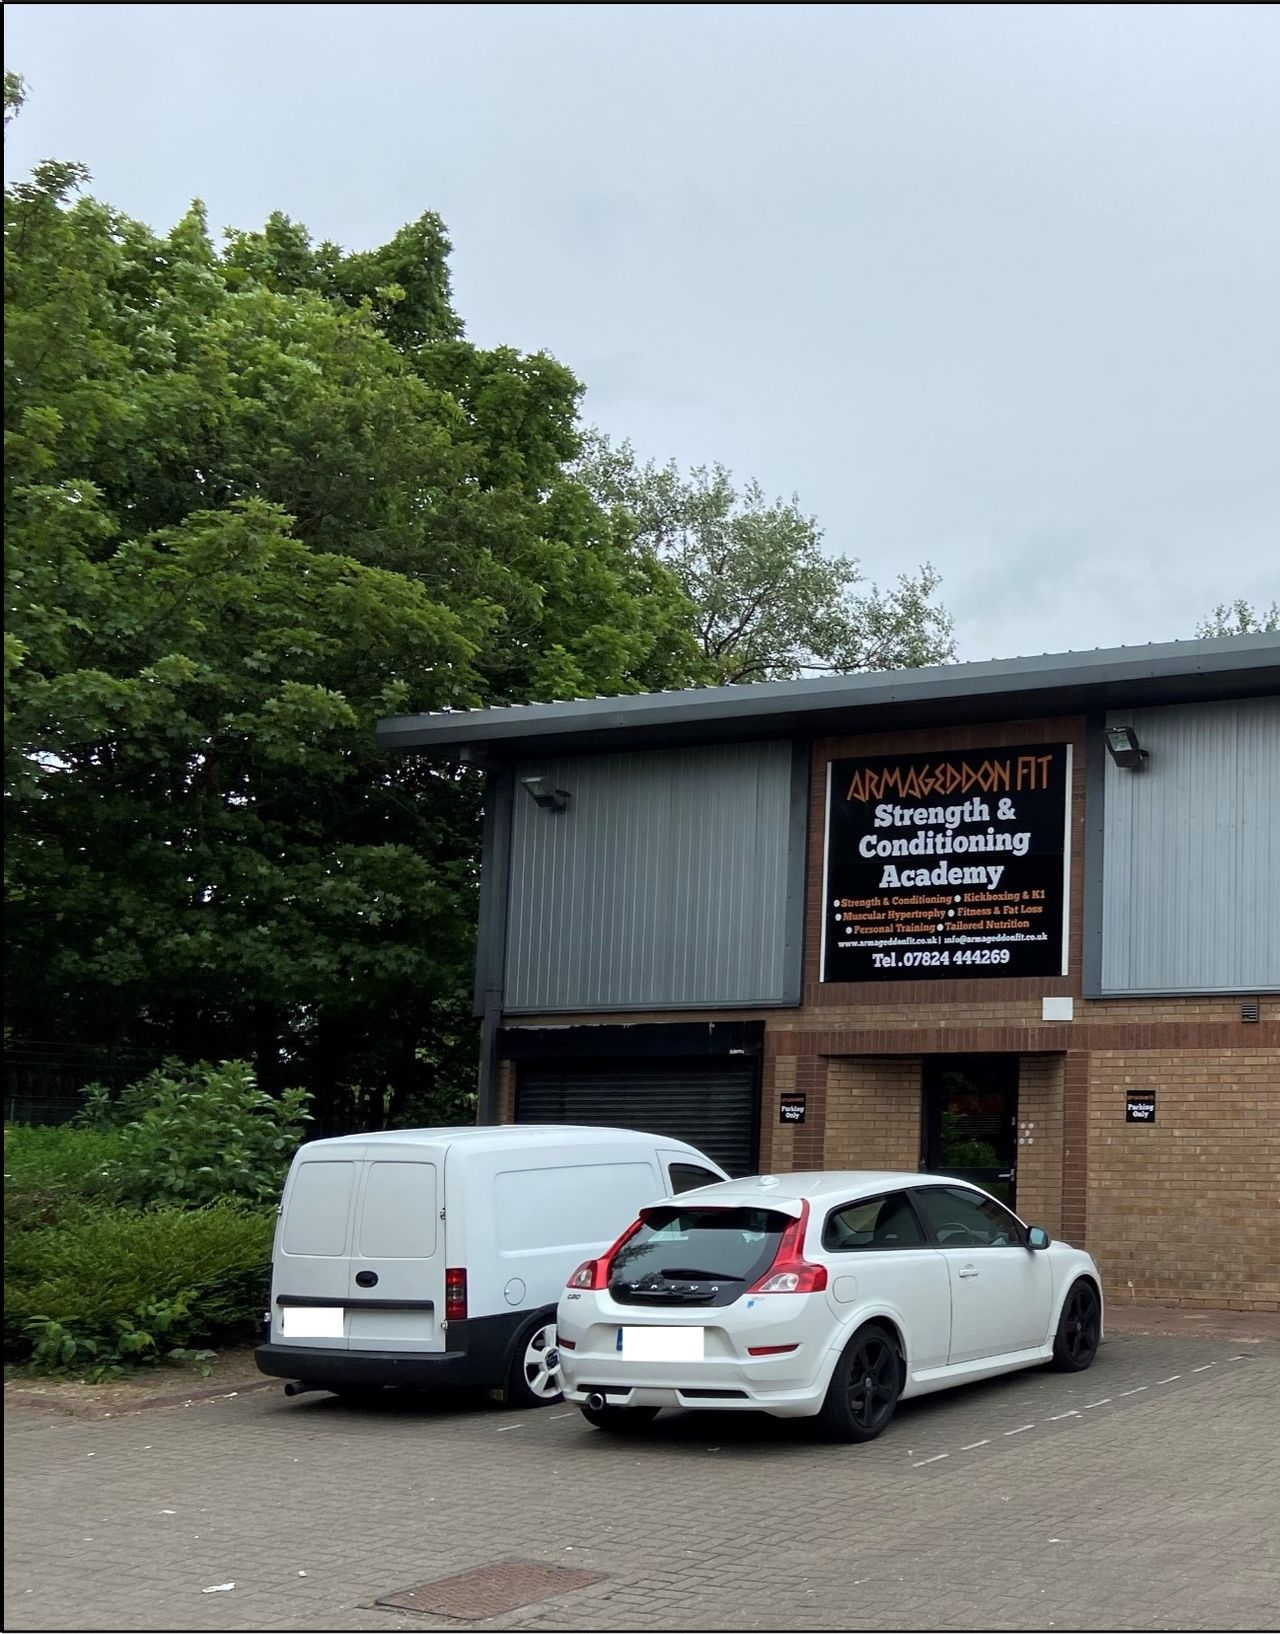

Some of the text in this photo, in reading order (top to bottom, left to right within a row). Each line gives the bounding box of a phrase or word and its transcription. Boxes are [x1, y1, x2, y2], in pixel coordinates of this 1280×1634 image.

[846, 755, 1053, 803] ARMAGEDDON FIT
[874, 797, 1016, 829] Strength &
[858, 827, 1031, 858] Conditioning
[879, 860, 1004, 890] Academy
[841, 894, 953, 908] Strength & Conditioning
[963, 890, 1046, 902] Kickboxing & K1
[842, 907, 946, 921] Muscular Hypertrophy
[957, 904, 1043, 916] Fitness & Fat Loss
[853, 922, 936, 934] Personal Training
[944, 918, 1030, 931] Tailored Nutrition
[837, 936, 938, 948] www.armageddonfit.co.uk
[953, 949, 1010, 965] 444269
[781, 1105, 805, 1114] Parking
[1127, 1103, 1154, 1112] Parking
[785, 1112, 800, 1120] Only
[1132, 1110, 1150, 1119] Only
